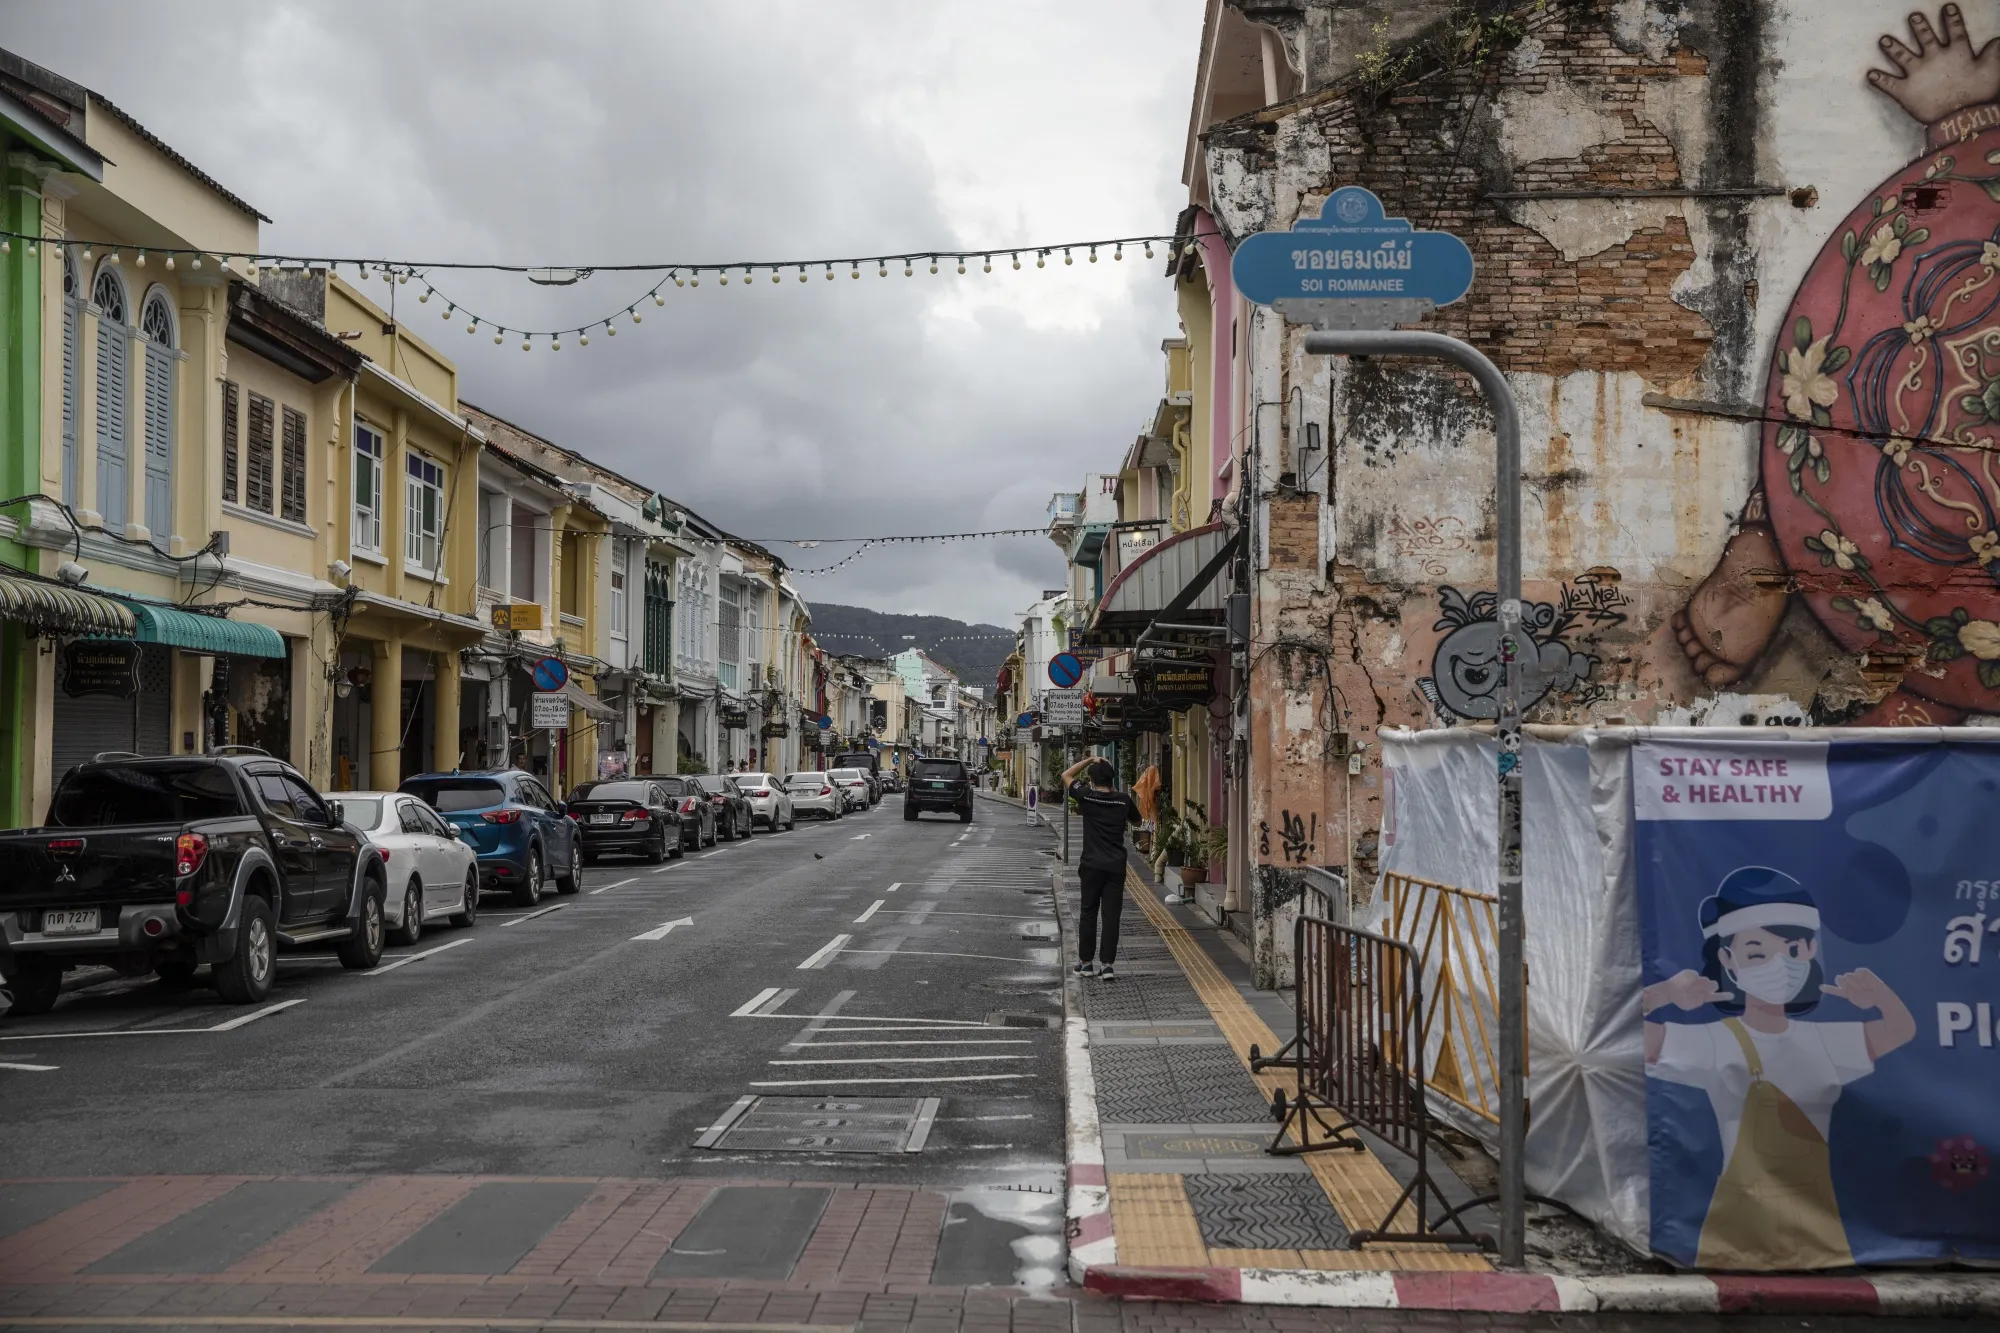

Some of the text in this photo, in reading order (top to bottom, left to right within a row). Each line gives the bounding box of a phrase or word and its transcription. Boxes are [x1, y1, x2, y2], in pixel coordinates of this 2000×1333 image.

[1301, 279, 1404, 292] SOI ROMMANEE
[1660, 758, 1788, 777] STAY SAFE
[1662, 784, 1803, 804] & HEALTHY
[69, 911, 96, 924] 7277
[1937, 1002, 2000, 1047] Pl
